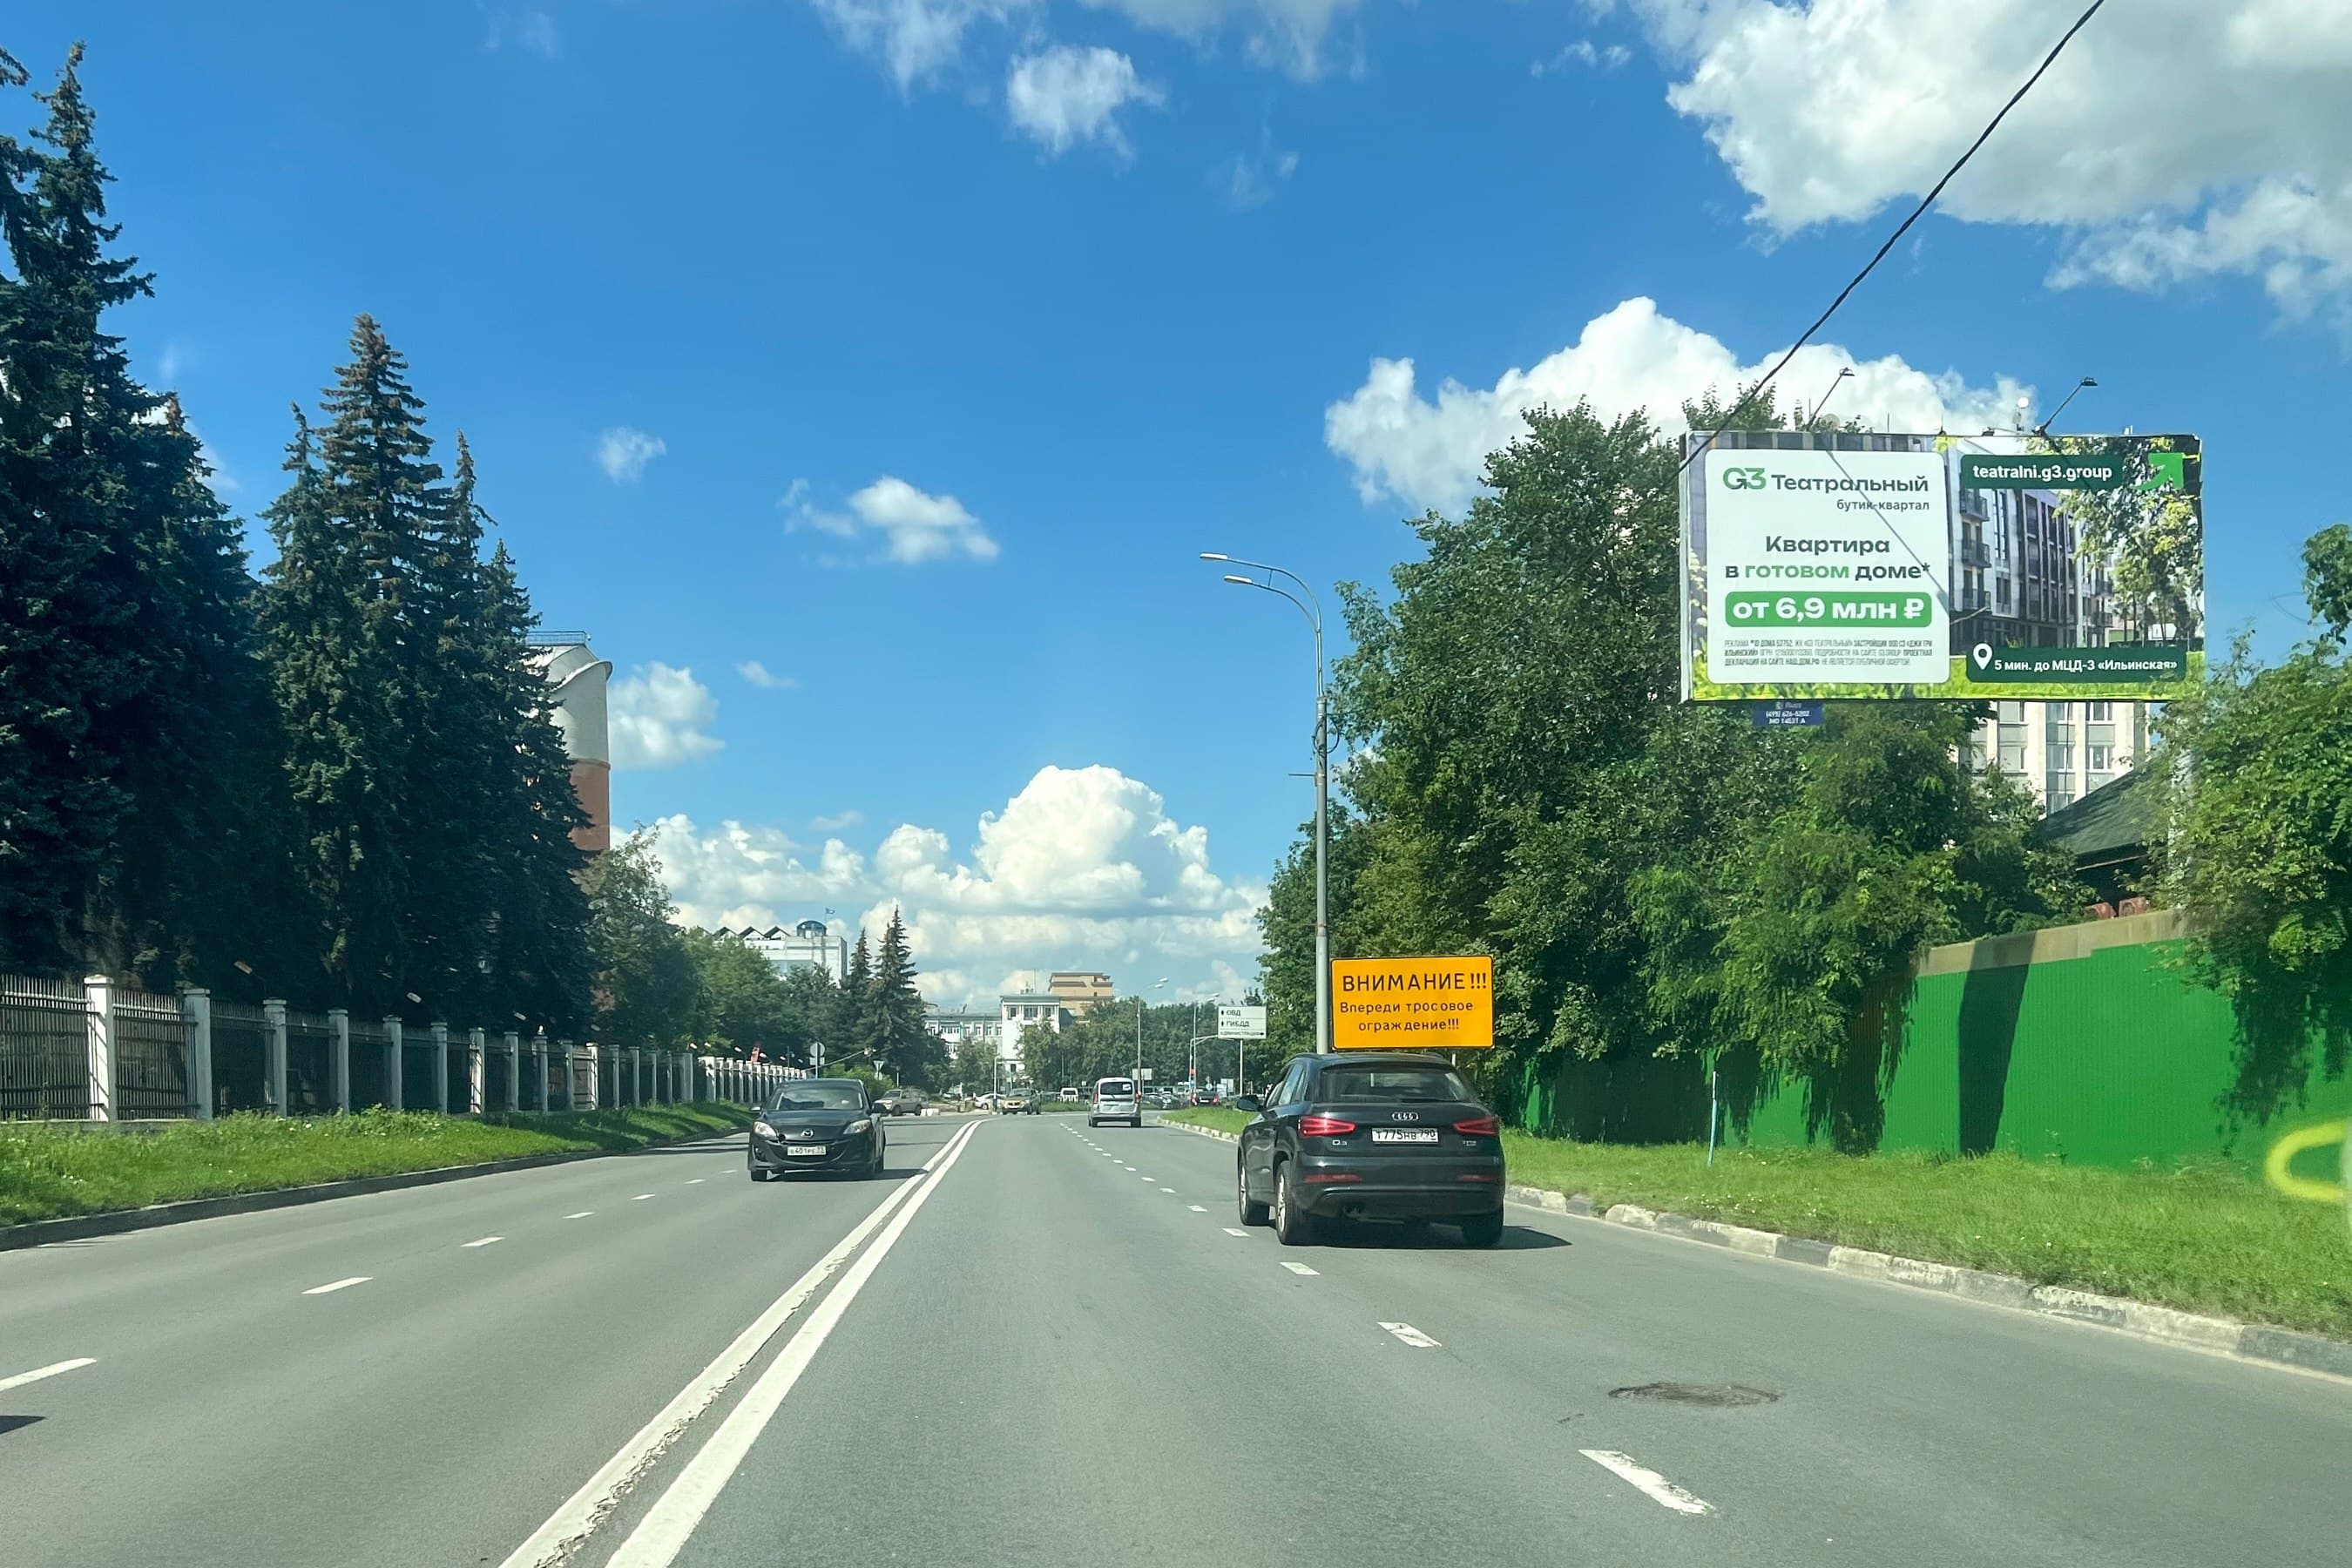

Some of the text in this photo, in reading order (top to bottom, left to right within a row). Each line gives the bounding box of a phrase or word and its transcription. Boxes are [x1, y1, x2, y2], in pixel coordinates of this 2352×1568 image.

[1972, 465, 2112, 481] teatralni.g3.group
[1771, 475, 1929, 493] Театральный
[1836, 499, 1930, 512] бутик-квартал
[1766, 536, 1890, 556] Квартира
[1725, 565, 1740, 578] в
[1745, 565, 1849, 578] готовом
[1733, 602, 1769, 619] от
[1775, 597, 1825, 622] 6,9
[1832, 602, 1897, 619] млн
[1994, 659, 2177, 672] 5 мин. до МЦД-3 «Ильинская»
[1340, 1002, 1474, 1015] Впереди тросовое
[1358, 1018, 1459, 1033] ограждение!!!
